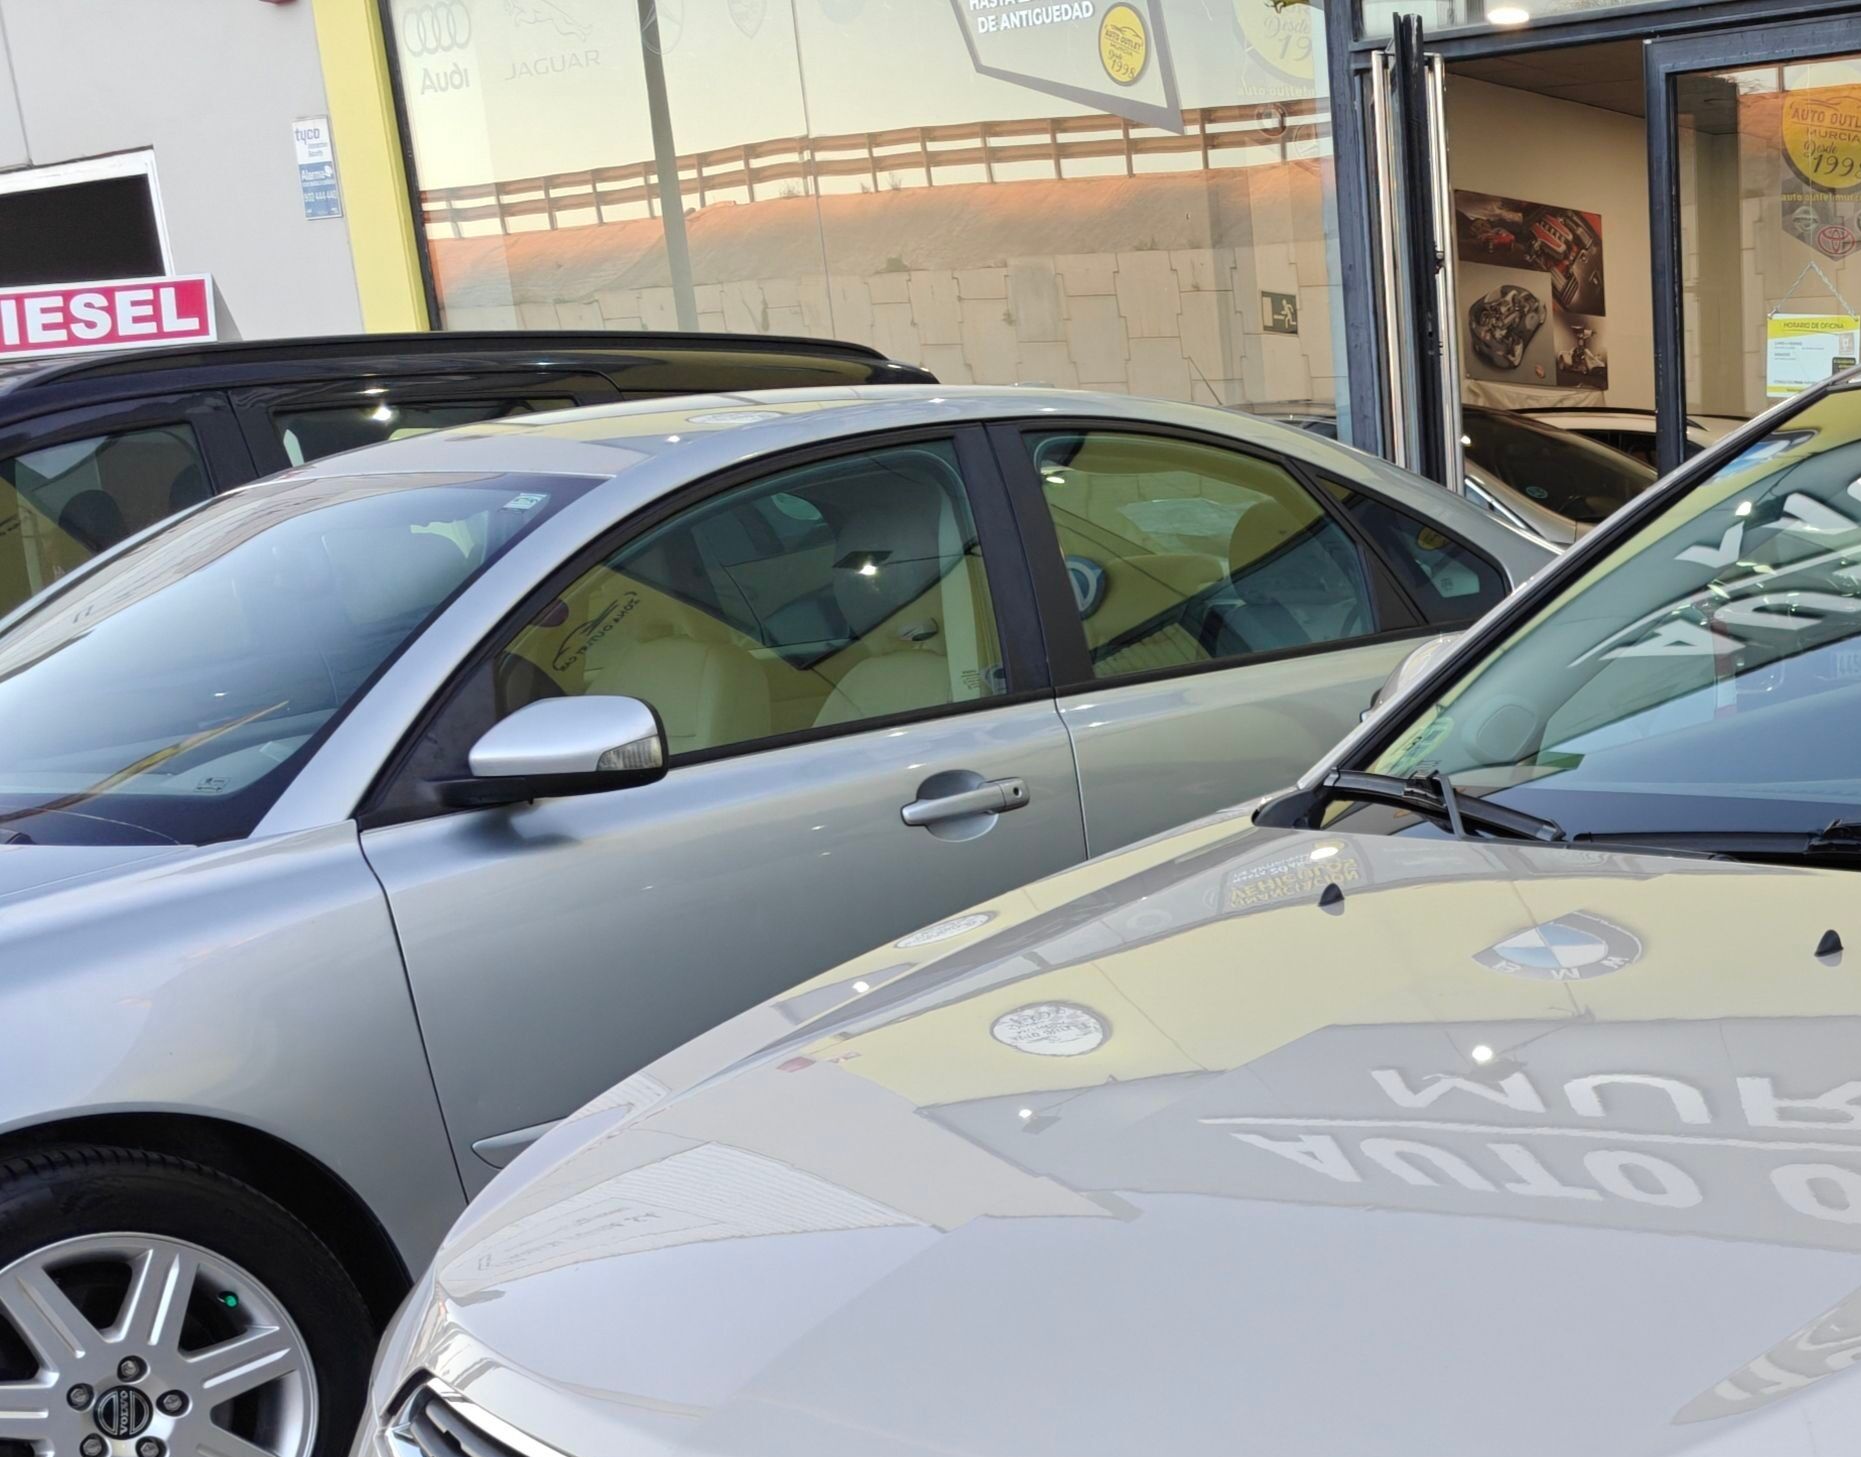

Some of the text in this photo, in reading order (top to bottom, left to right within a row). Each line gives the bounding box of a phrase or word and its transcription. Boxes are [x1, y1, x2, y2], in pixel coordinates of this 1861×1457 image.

[978, 15, 997, 33] DE
[504, 49, 600, 81] JAGUAR
[1111, 59, 1136, 79] 1998
[420, 62, 470, 95] Audi
[1791, 107, 1825, 122] AUTO
[295, 128, 320, 145] tyco
[1806, 128, 1861, 143] MURCIA
[120, 1390, 128, 1435] VOLVO
